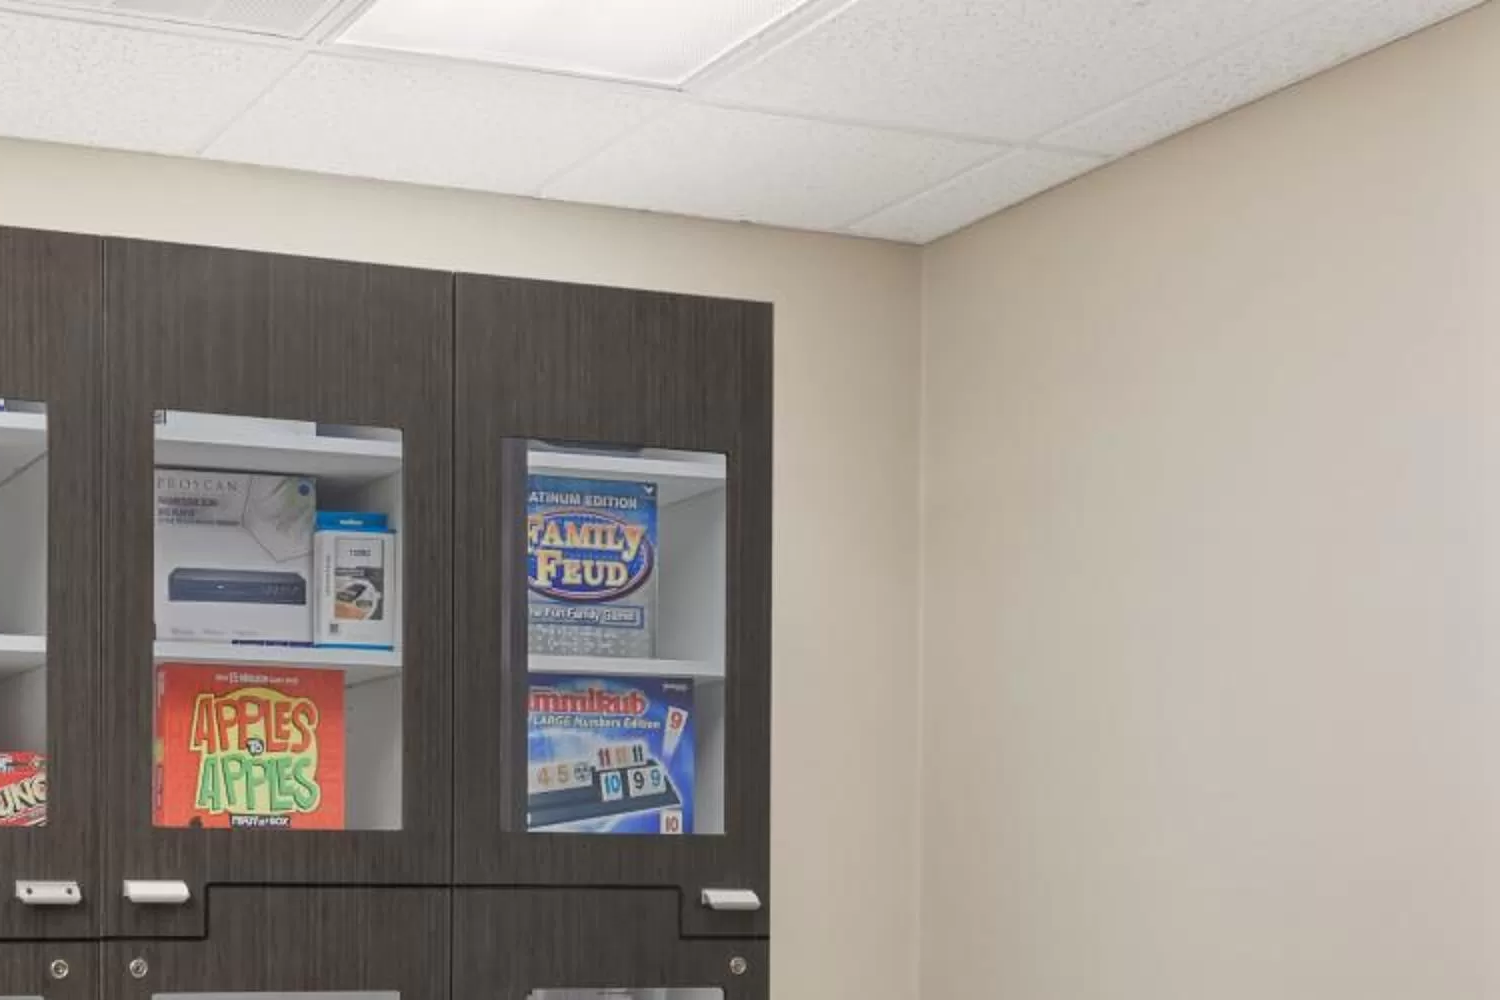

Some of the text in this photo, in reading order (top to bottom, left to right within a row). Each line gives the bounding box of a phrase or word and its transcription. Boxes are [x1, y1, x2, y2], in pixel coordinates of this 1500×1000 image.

[585, 494, 638, 510] EDITION
[533, 550, 630, 587] FEUD
[192, 695, 318, 754] APPLES
[669, 711, 683, 730] 9
[197, 754, 319, 812] APPLES
[604, 774, 621, 794] 10
[632, 771, 645, 790] 9
[665, 815, 679, 832] 10
